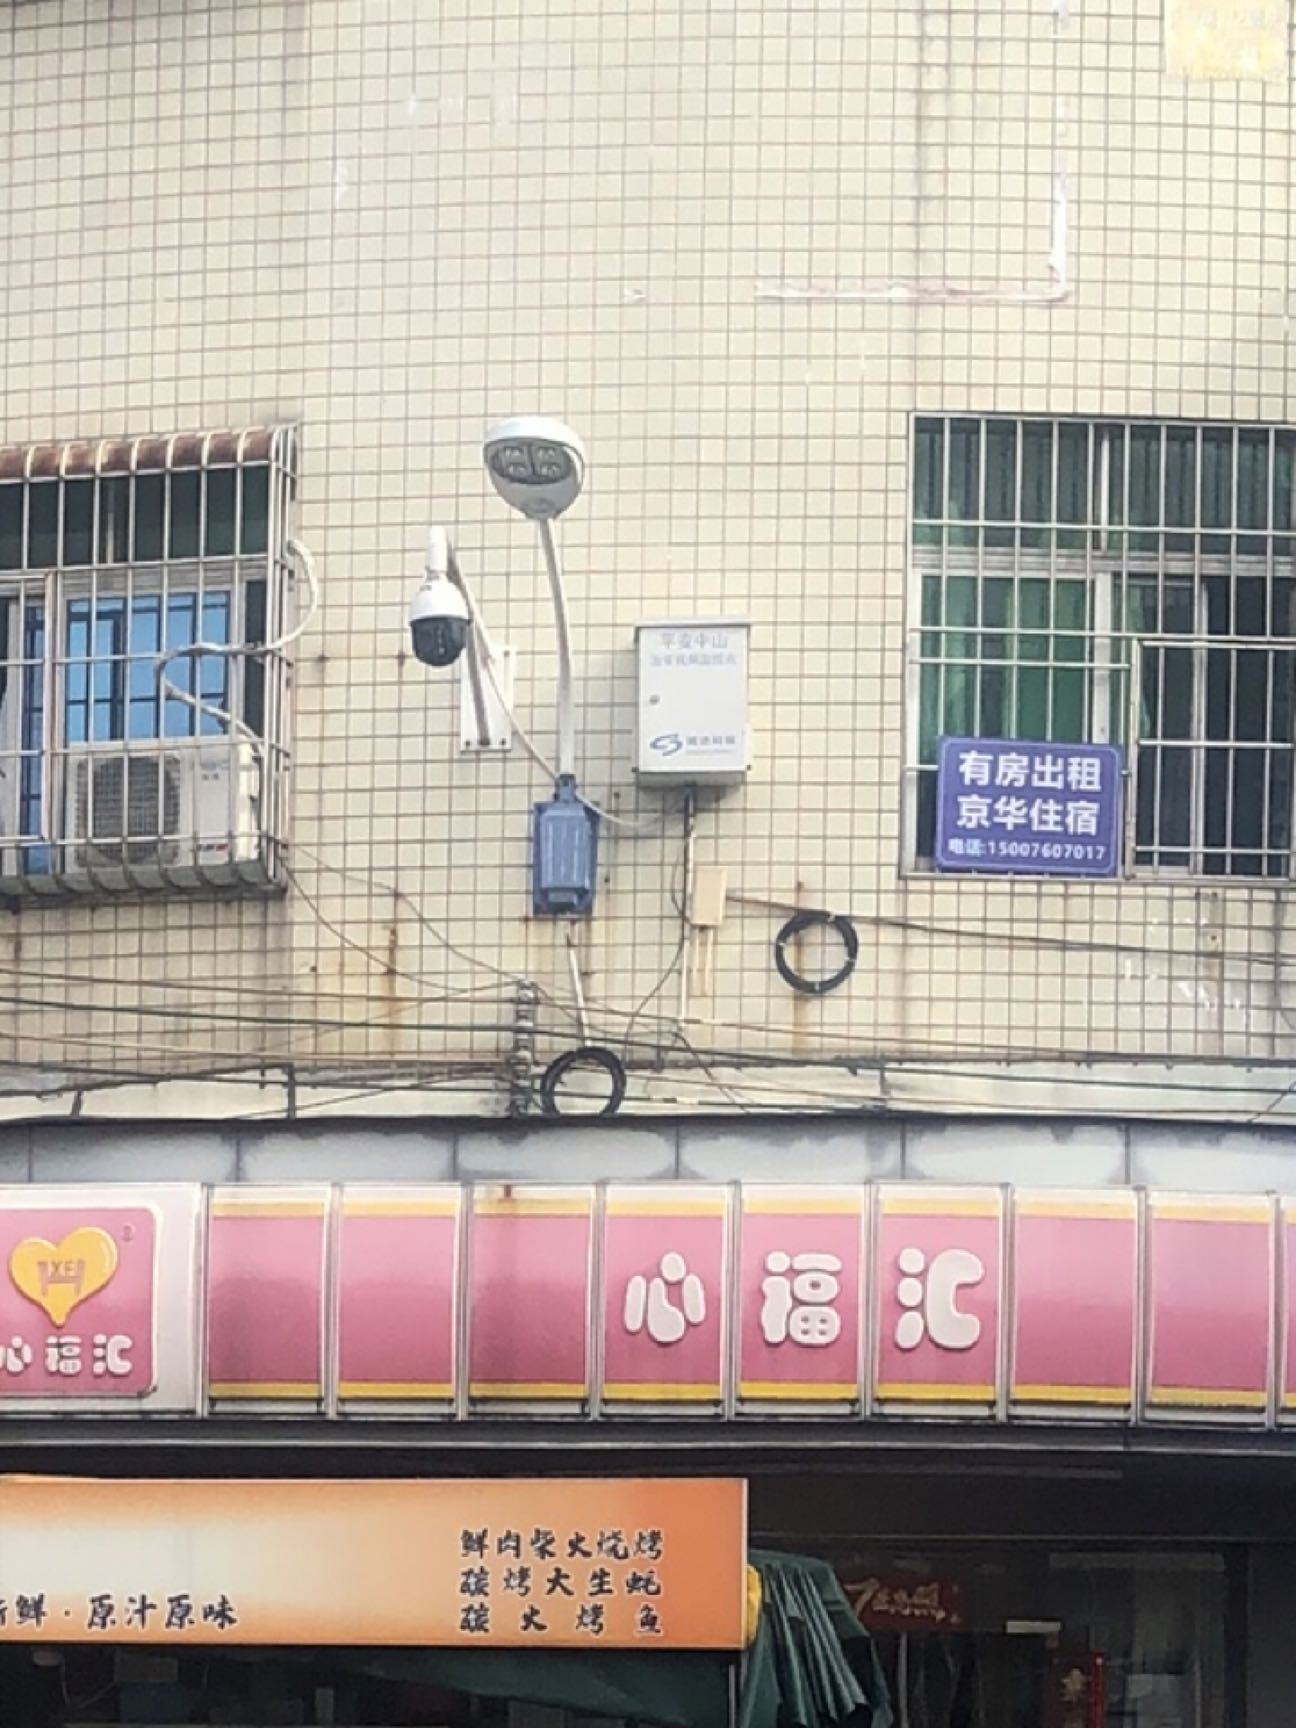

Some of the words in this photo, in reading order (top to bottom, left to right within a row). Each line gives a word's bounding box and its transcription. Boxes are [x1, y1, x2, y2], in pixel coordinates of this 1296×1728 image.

[958, 750, 1102, 792] 有房出租
[956, 794, 1101, 836] 京华住宿
[624, 1248, 985, 1350] 心福汇
[460, 1528, 664, 1561] 鲜肉柴火烧烤
